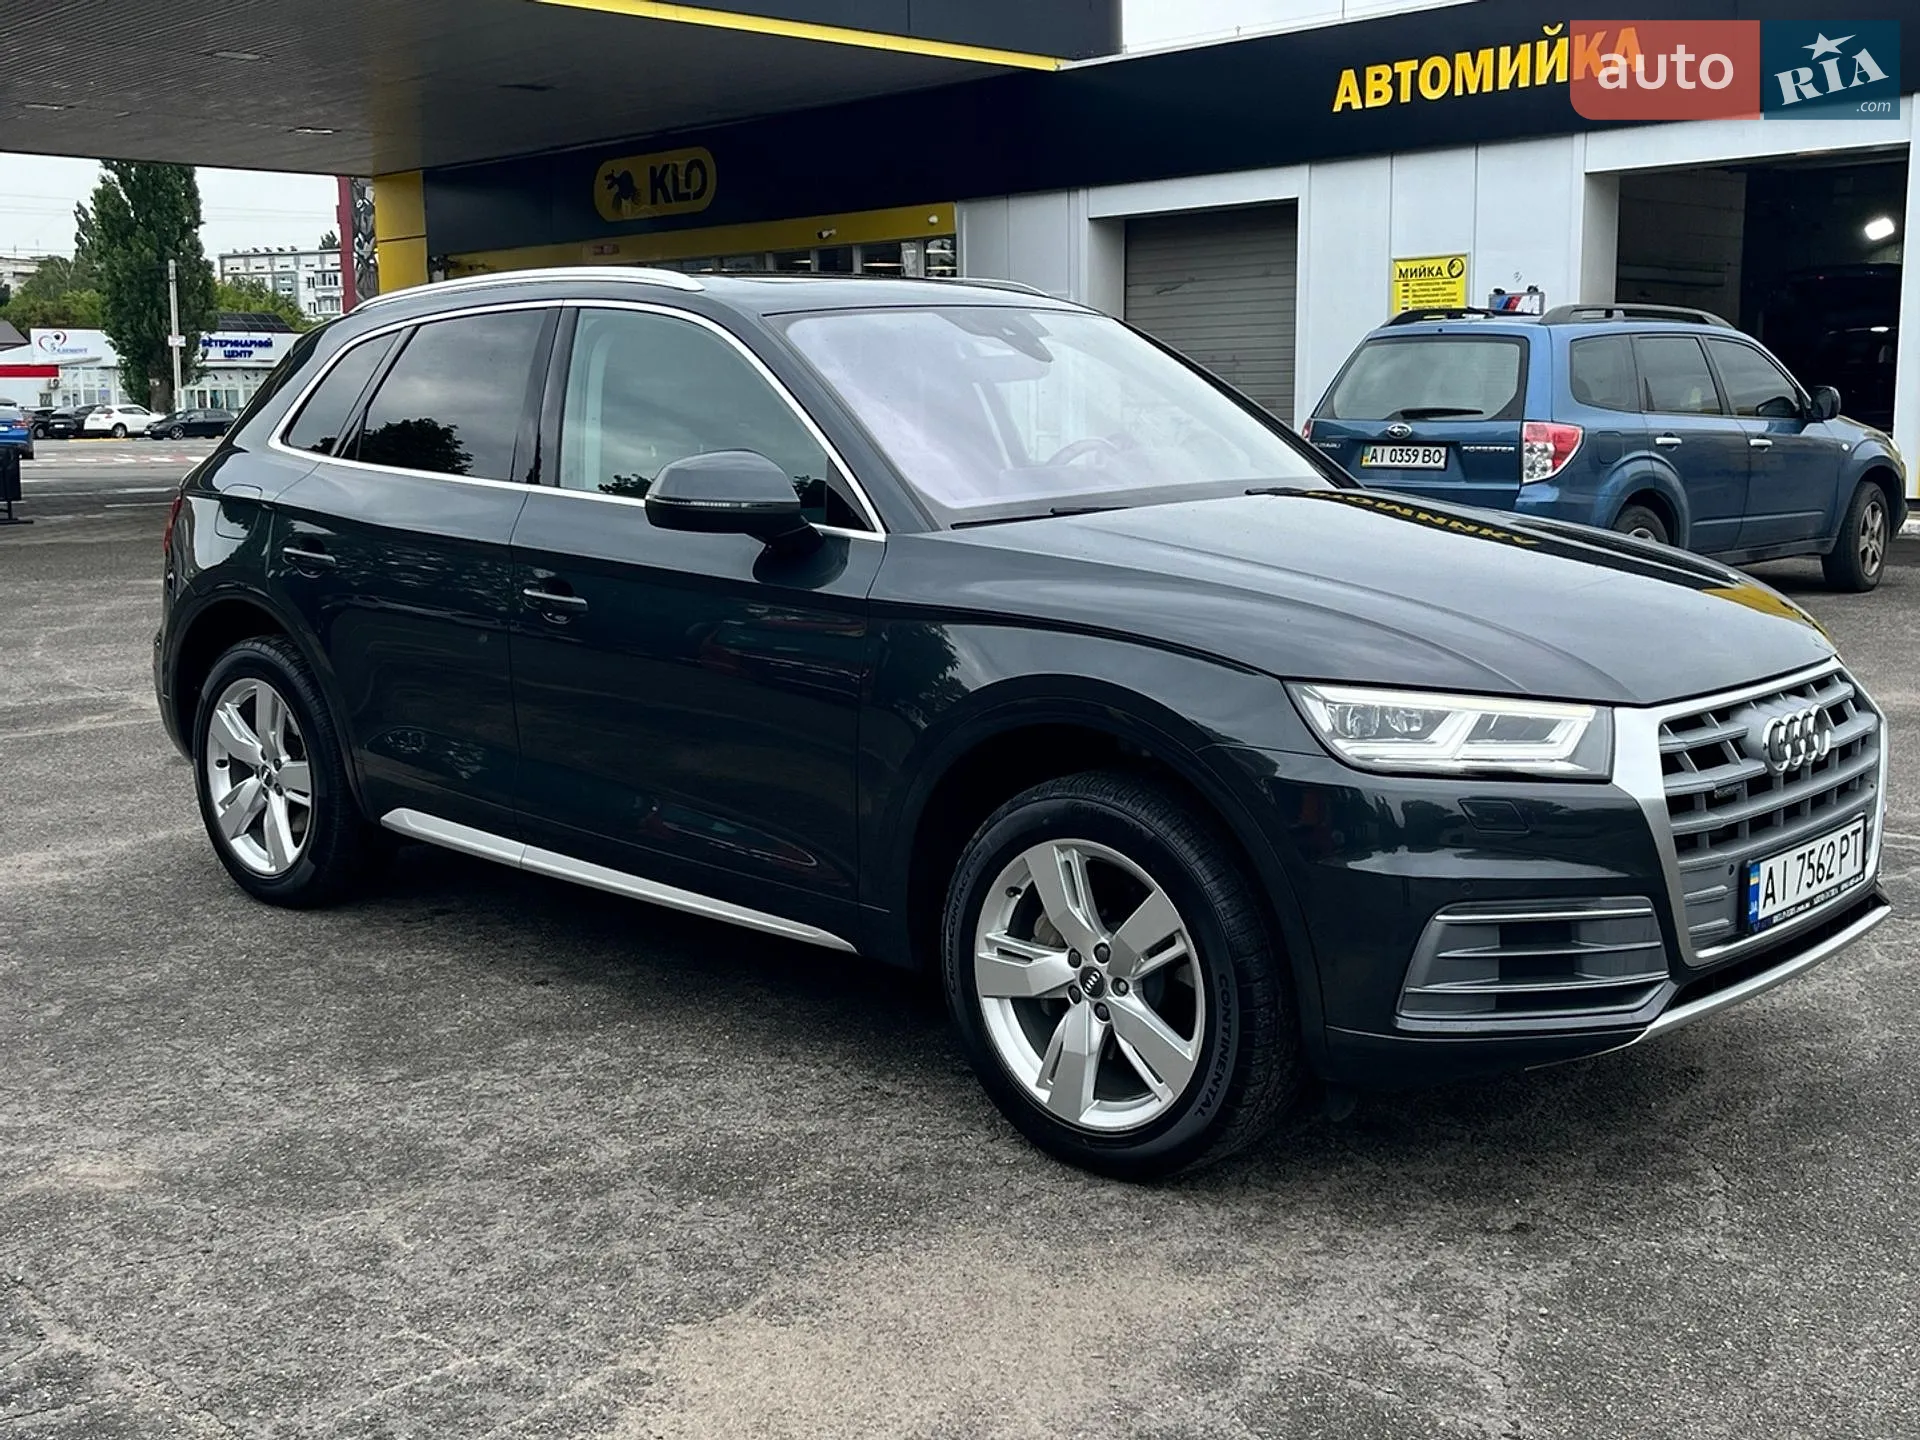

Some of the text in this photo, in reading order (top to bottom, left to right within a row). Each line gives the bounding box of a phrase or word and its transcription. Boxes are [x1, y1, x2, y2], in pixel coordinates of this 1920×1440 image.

[1332, 22, 1646, 113] АВТОМИЙКА
[649, 158, 708, 206] KLO
[1398, 264, 1444, 279] МИЙКА
[1369, 445, 1442, 464] AI 0359 BO
[1762, 827, 1862, 910] AI 7562 PT
[1194, 972, 1233, 1118] CONTINENTAL
